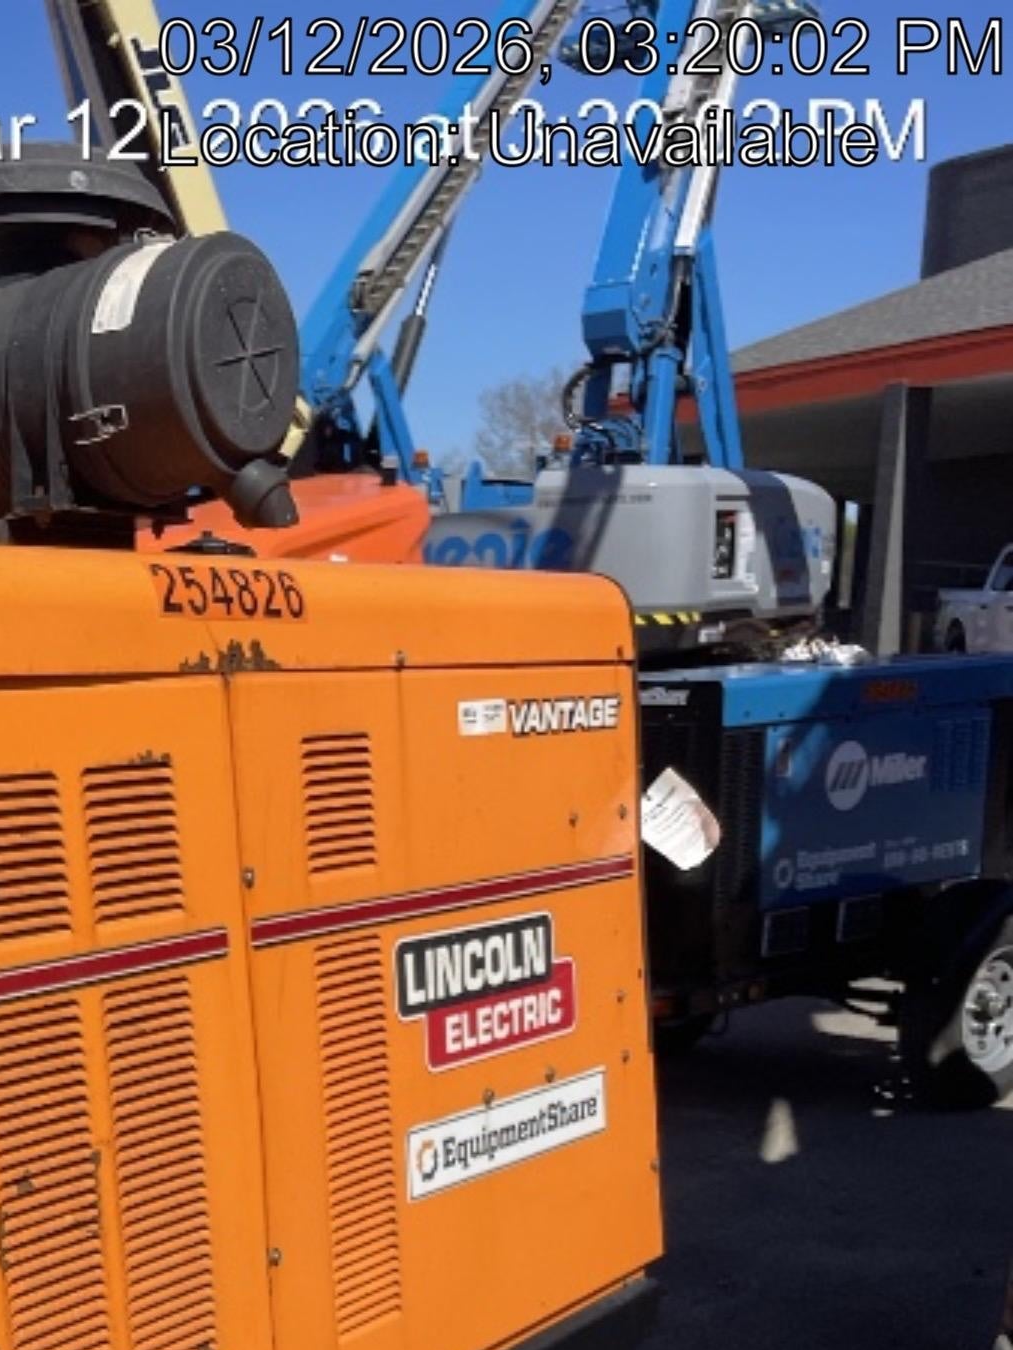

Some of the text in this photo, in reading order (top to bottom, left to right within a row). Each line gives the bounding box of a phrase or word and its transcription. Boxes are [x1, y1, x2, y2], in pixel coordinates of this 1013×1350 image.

[422, 517, 575, 572] enie
[150, 564, 304, 619] 254826
[507, 694, 621, 737] VANTAGE
[403, 926, 546, 1006] LINCOLN
[444, 989, 563, 1055] ELECTRIC
[441, 1096, 598, 1170] EquipmentShare
